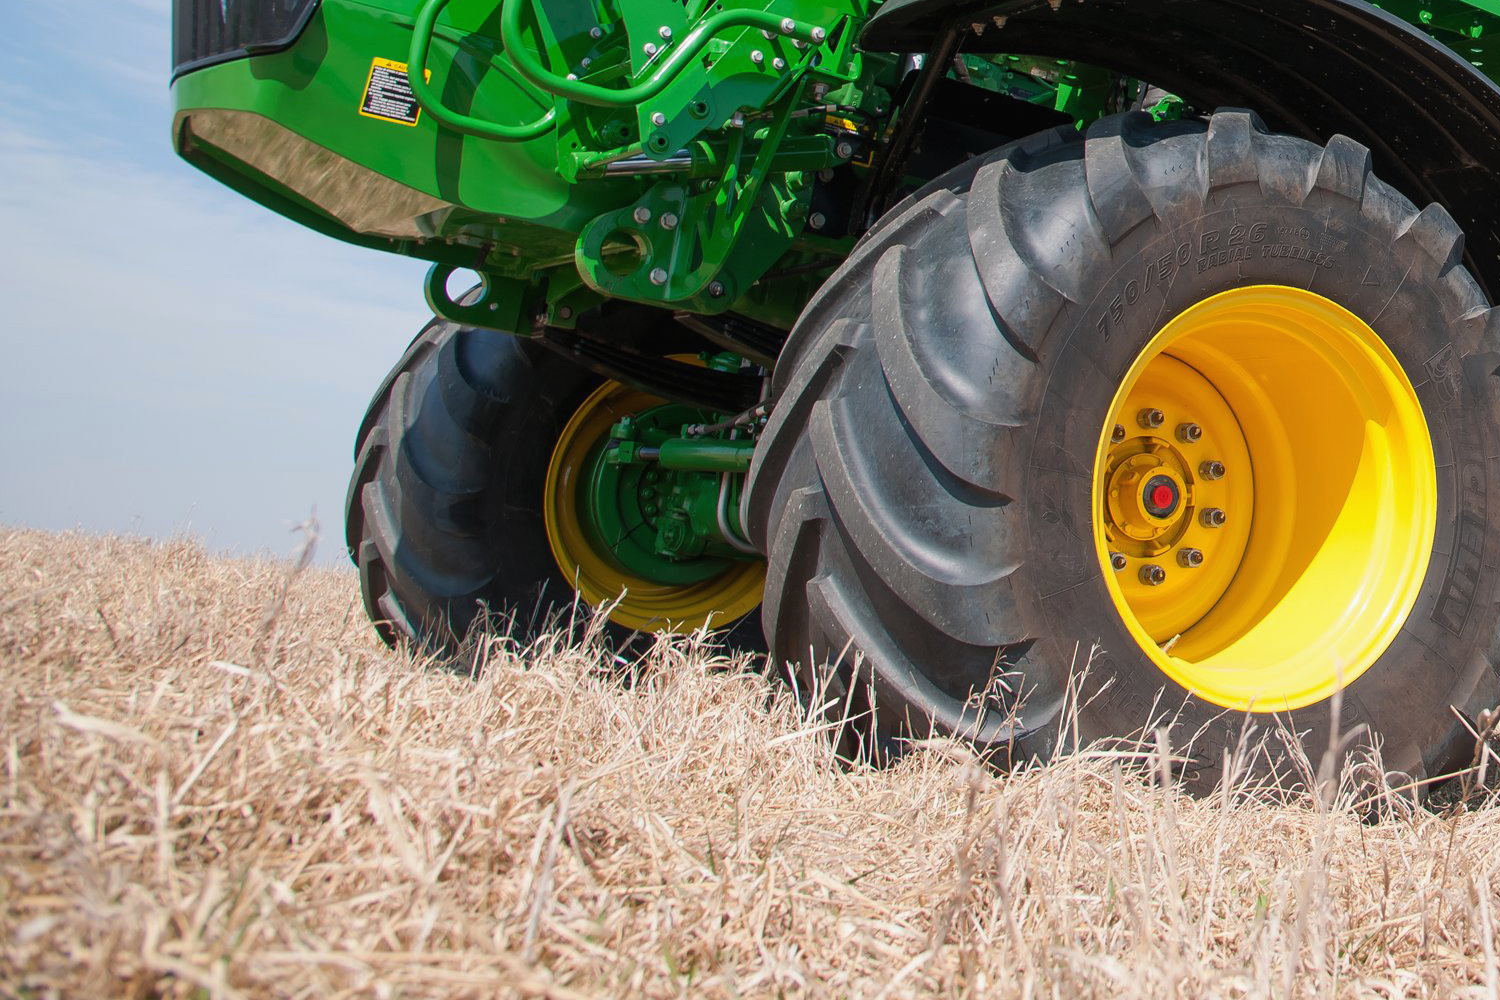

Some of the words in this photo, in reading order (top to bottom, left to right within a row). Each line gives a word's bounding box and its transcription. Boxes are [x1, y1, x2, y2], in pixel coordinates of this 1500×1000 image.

[1096, 242, 1192, 343] 750/50
[1200, 229, 1220, 256] R
[1228, 222, 1268, 246] 26
[1196, 246, 1252, 274] RADIAL
[1262, 245, 1336, 268] TUBELESS
